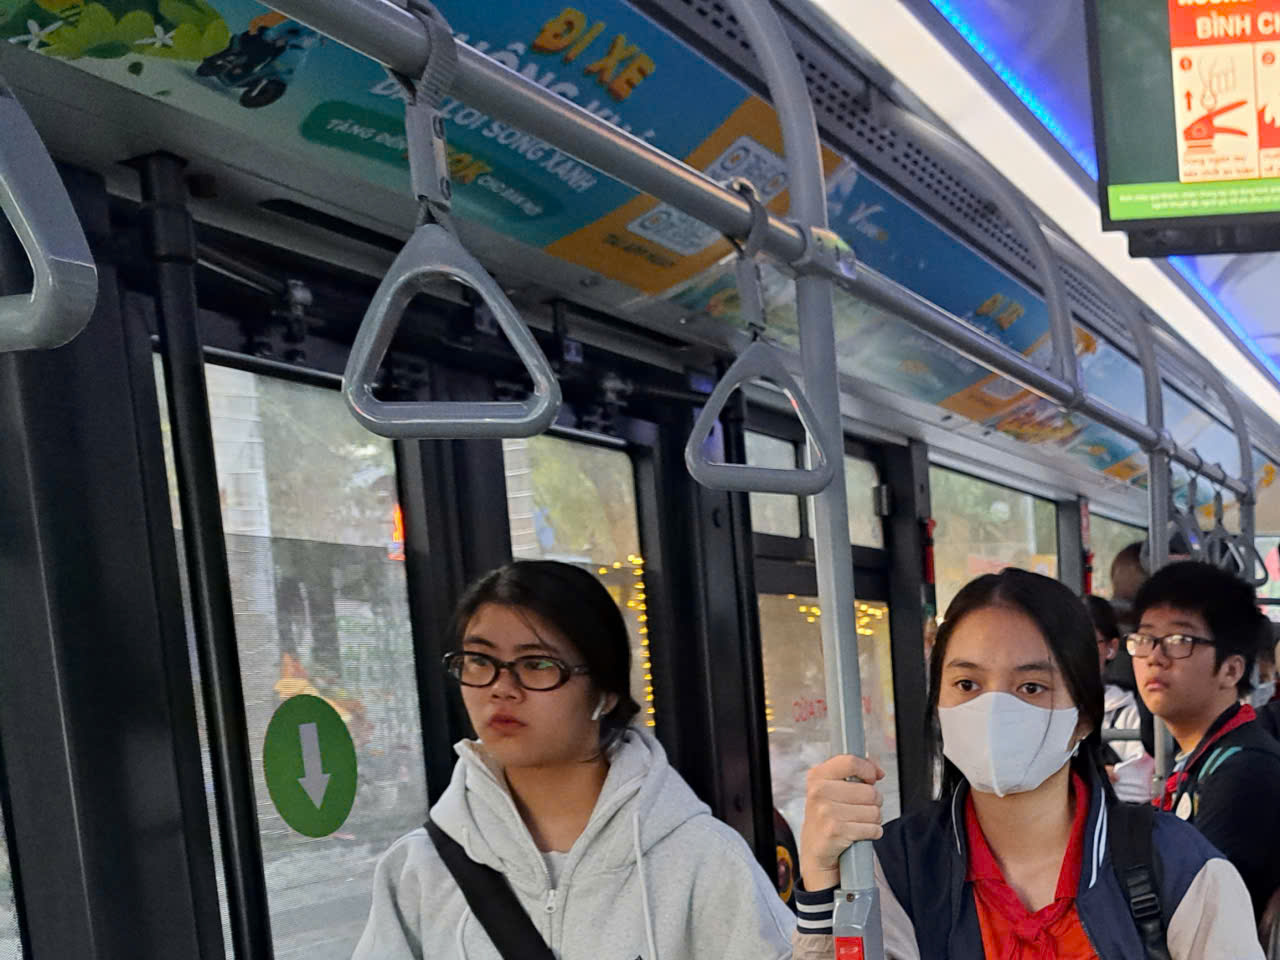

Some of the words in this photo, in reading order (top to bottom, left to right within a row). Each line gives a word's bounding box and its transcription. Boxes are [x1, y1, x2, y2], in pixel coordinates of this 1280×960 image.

[1195, 11, 1251, 39] BÌNH
[531, 7, 606, 64] ĐI
[584, 33, 657, 102] XE
[539, 150, 598, 193] XANH
